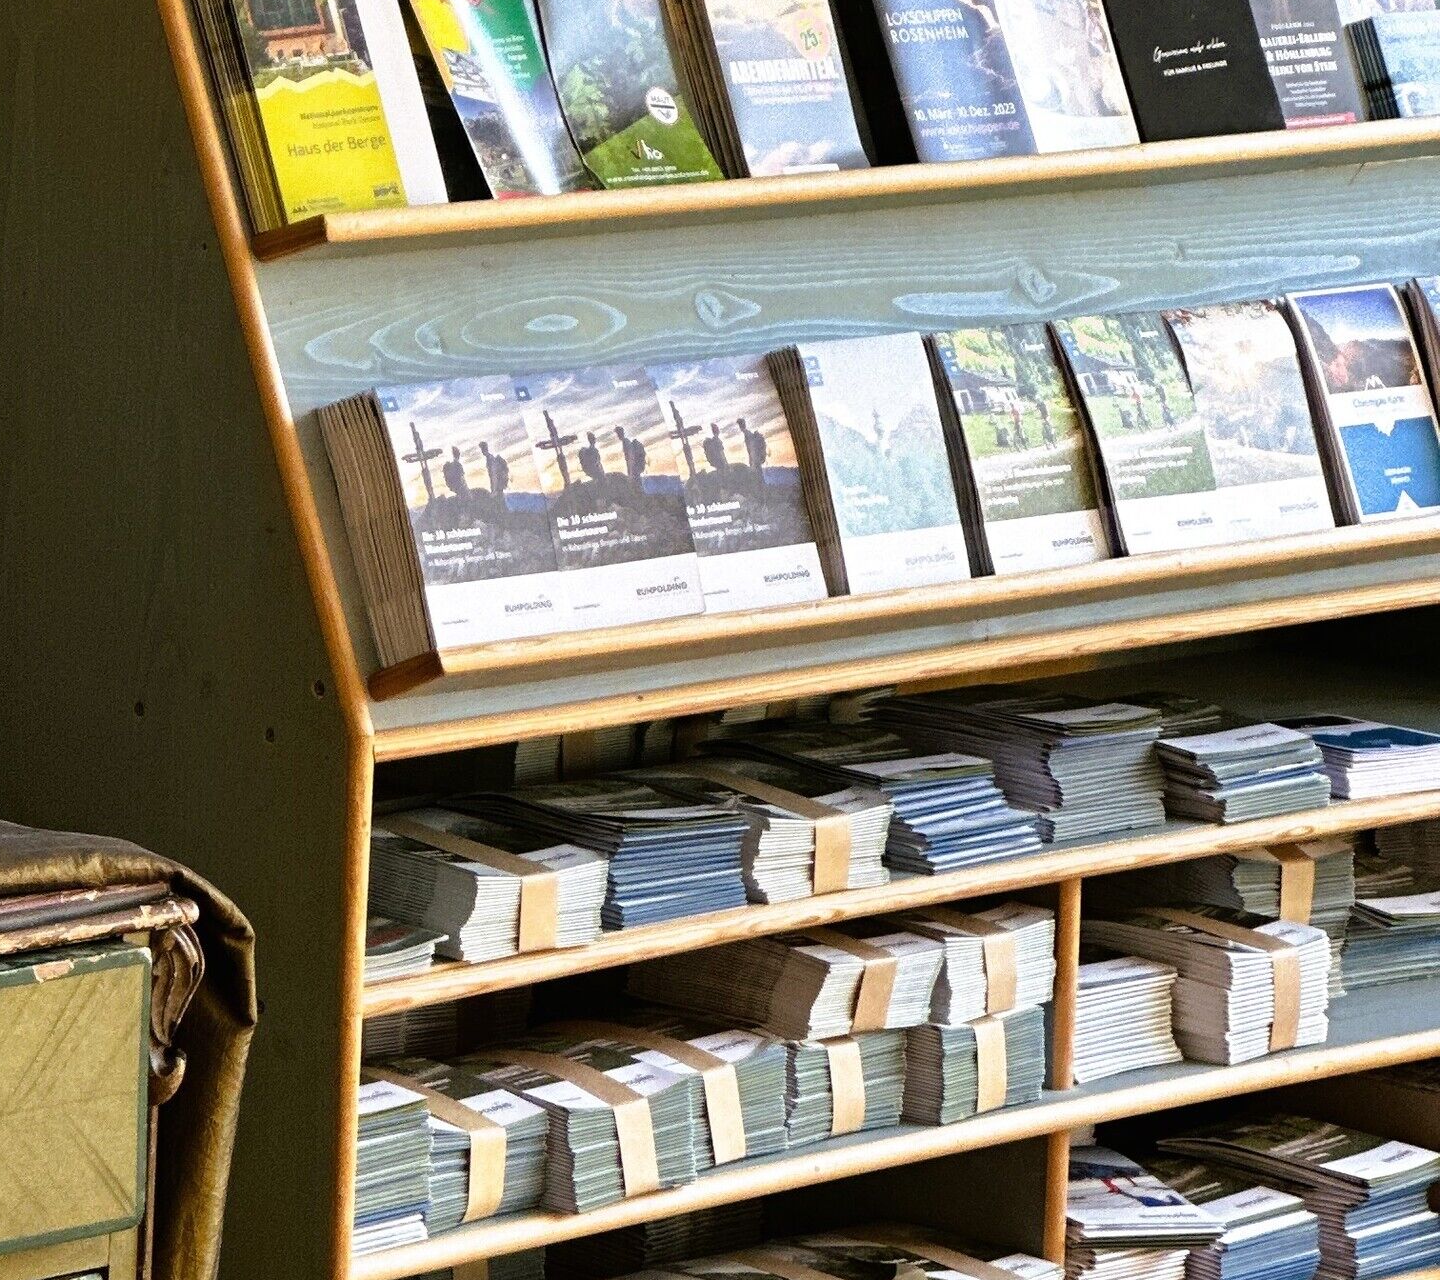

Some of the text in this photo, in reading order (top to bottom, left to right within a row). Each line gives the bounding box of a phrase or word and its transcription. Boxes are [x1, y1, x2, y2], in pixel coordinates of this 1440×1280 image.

[885, 9, 964, 28] LOKSCHUPPEN
[890, 26, 970, 44] ROSENHEIM
[287, 134, 386, 158] Haus der Berge
[763, 568, 810, 583] RUHPOLDING
[636, 579, 688, 597] RUHPOLDING
